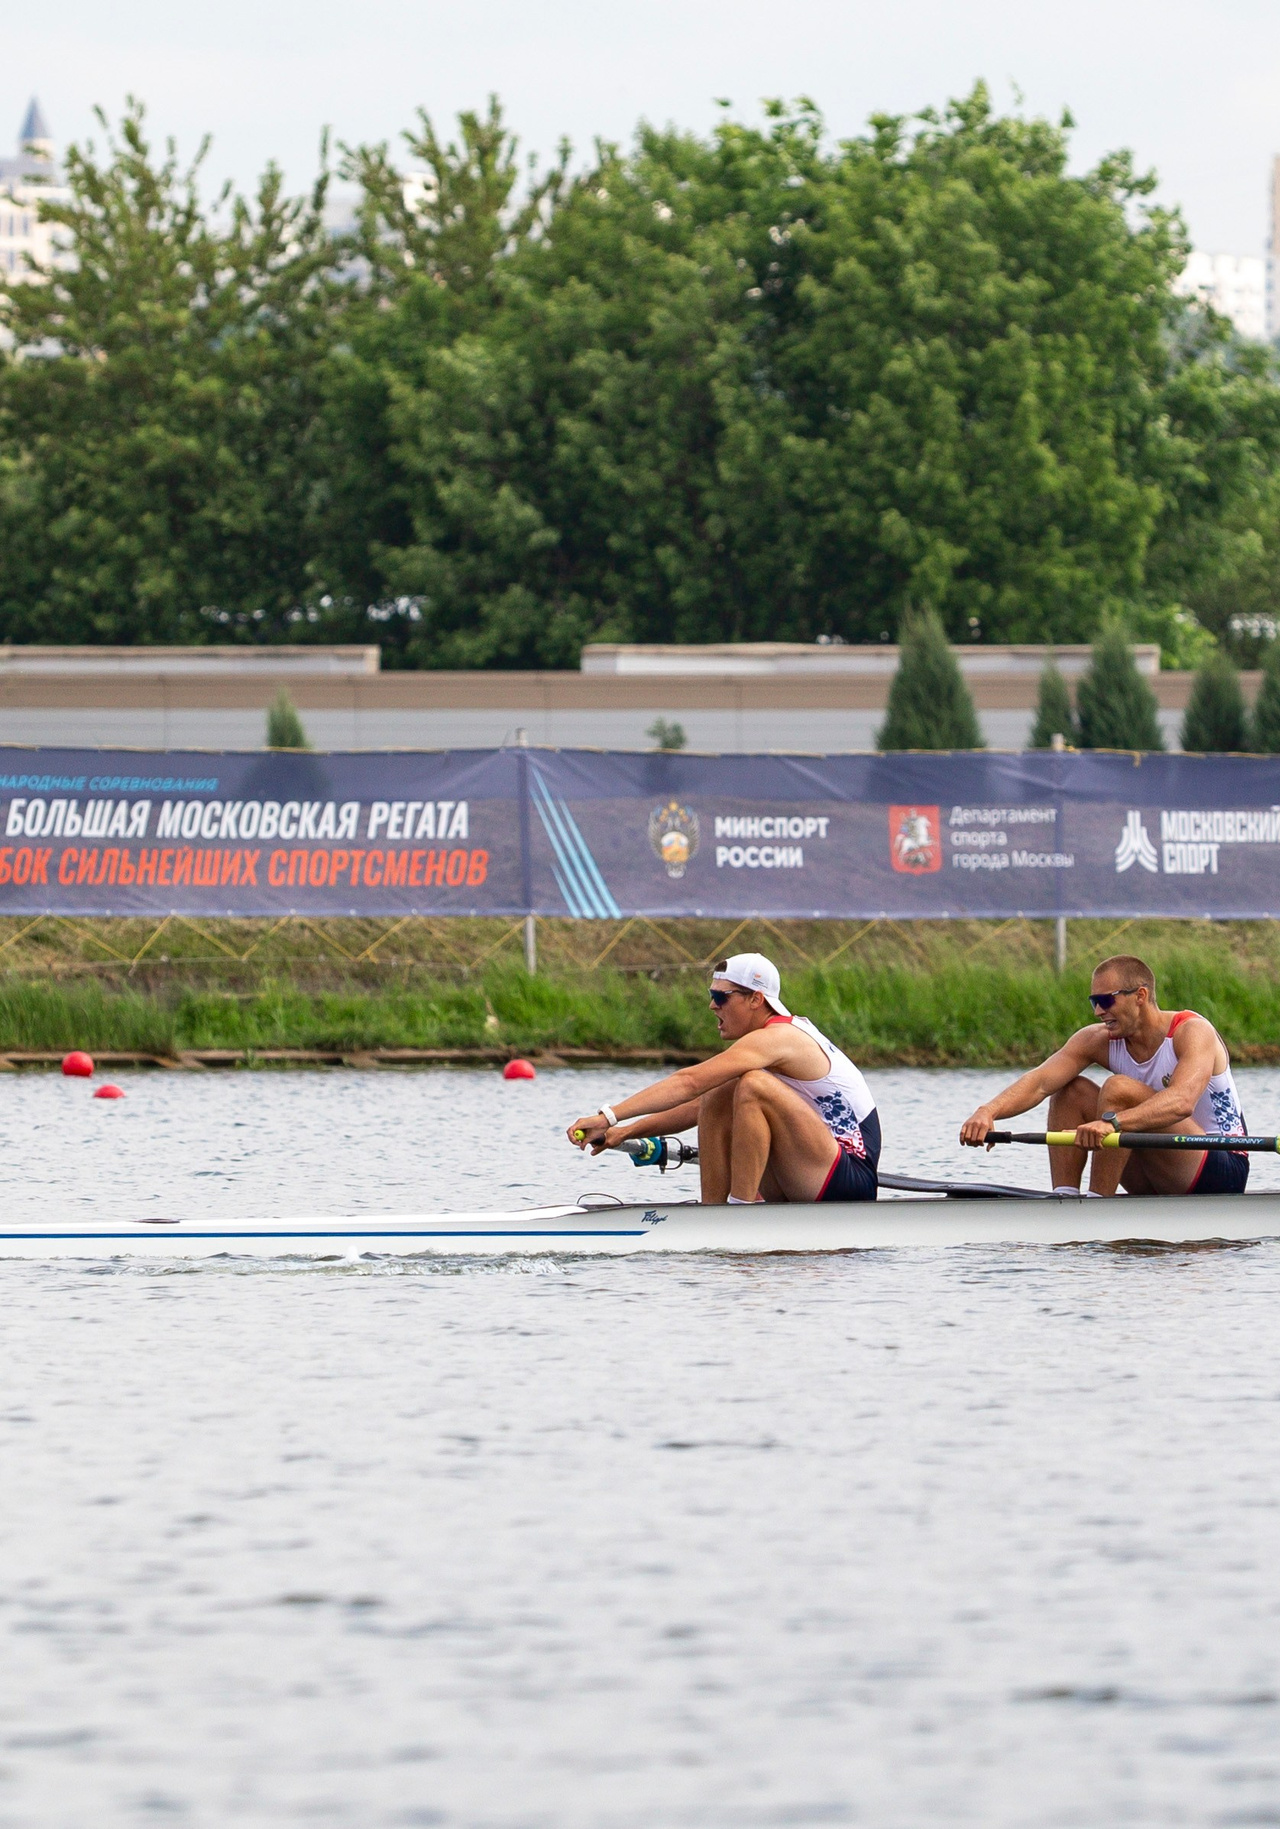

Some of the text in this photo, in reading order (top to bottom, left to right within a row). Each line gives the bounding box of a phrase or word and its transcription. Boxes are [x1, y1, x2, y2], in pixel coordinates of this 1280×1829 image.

[88, 776, 219, 791] СОРЕВНОВАНИЯ
[5, 798, 469, 840] БОЛЬШАЯ МОСКОВСКАЯ РЕГАТА
[715, 816, 830, 839] МИНСПОРТ
[949, 806, 1058, 827] Департамент
[950, 831, 1008, 850] спорта
[58, 846, 261, 887] СИЛЬНЕЙШИХ
[267, 849, 490, 888] СПОРТСМЕНОВ
[716, 846, 804, 868] РОССИИ
[952, 850, 1075, 872] города Москвы
[1163, 843, 1220, 875] СПОРТ
[1229, 1137, 1263, 1145] SKINNY
